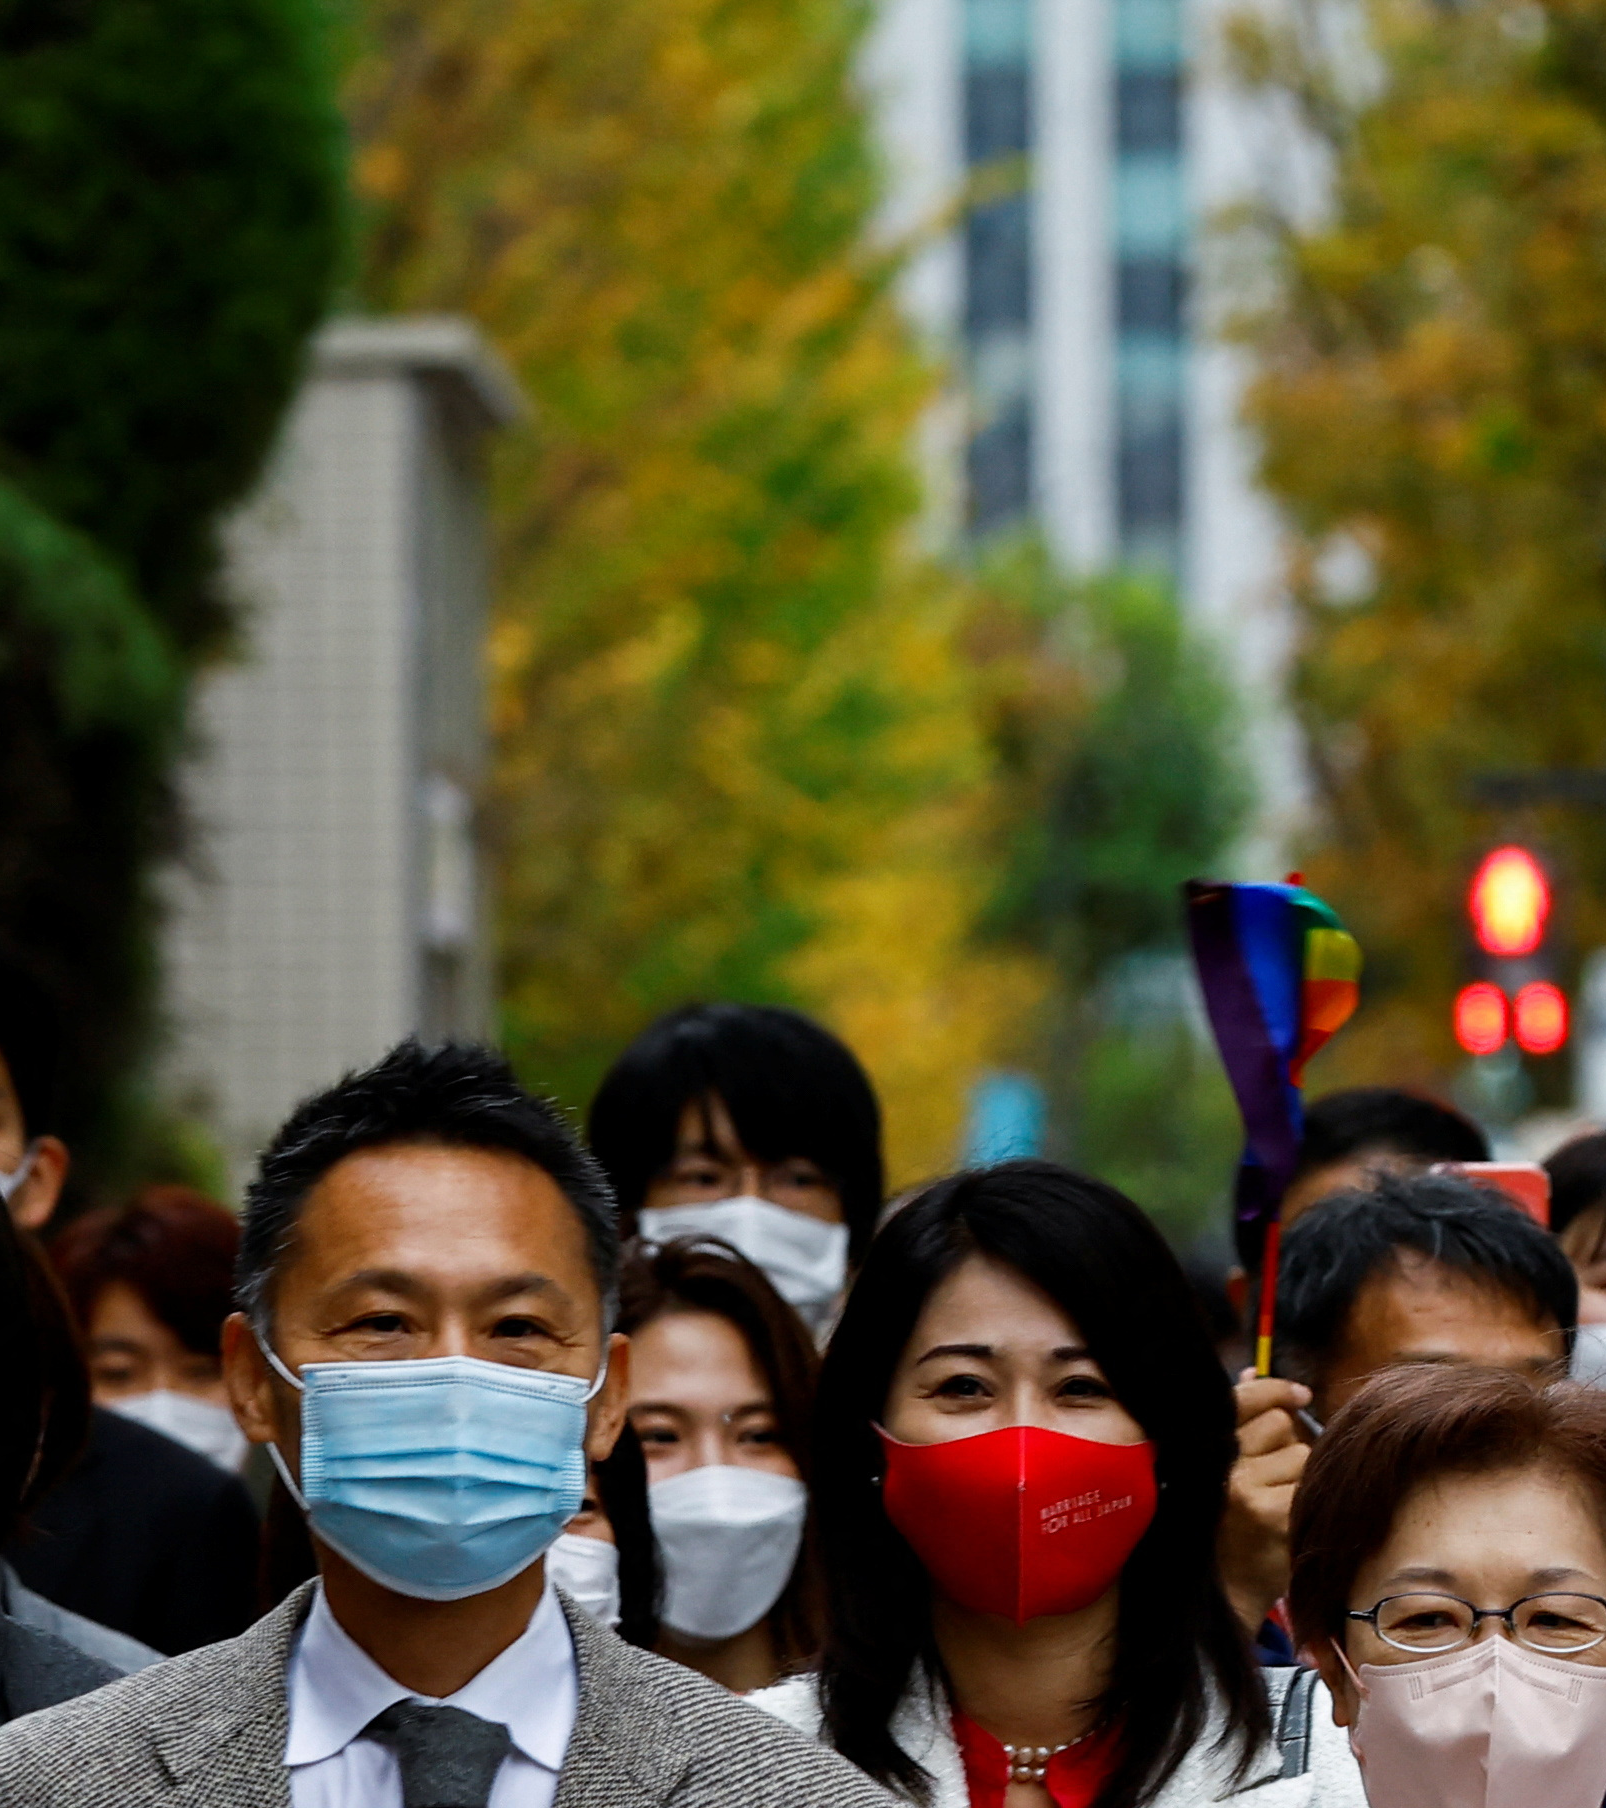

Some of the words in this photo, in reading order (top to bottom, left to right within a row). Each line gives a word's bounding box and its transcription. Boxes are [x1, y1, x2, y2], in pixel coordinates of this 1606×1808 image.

[1040, 1489, 1101, 1520] MARRIAGE
[1040, 1515, 1069, 1535] FOR
[1073, 1508, 1092, 1524] ALL
[1096, 1494, 1133, 1517] JAPAN
